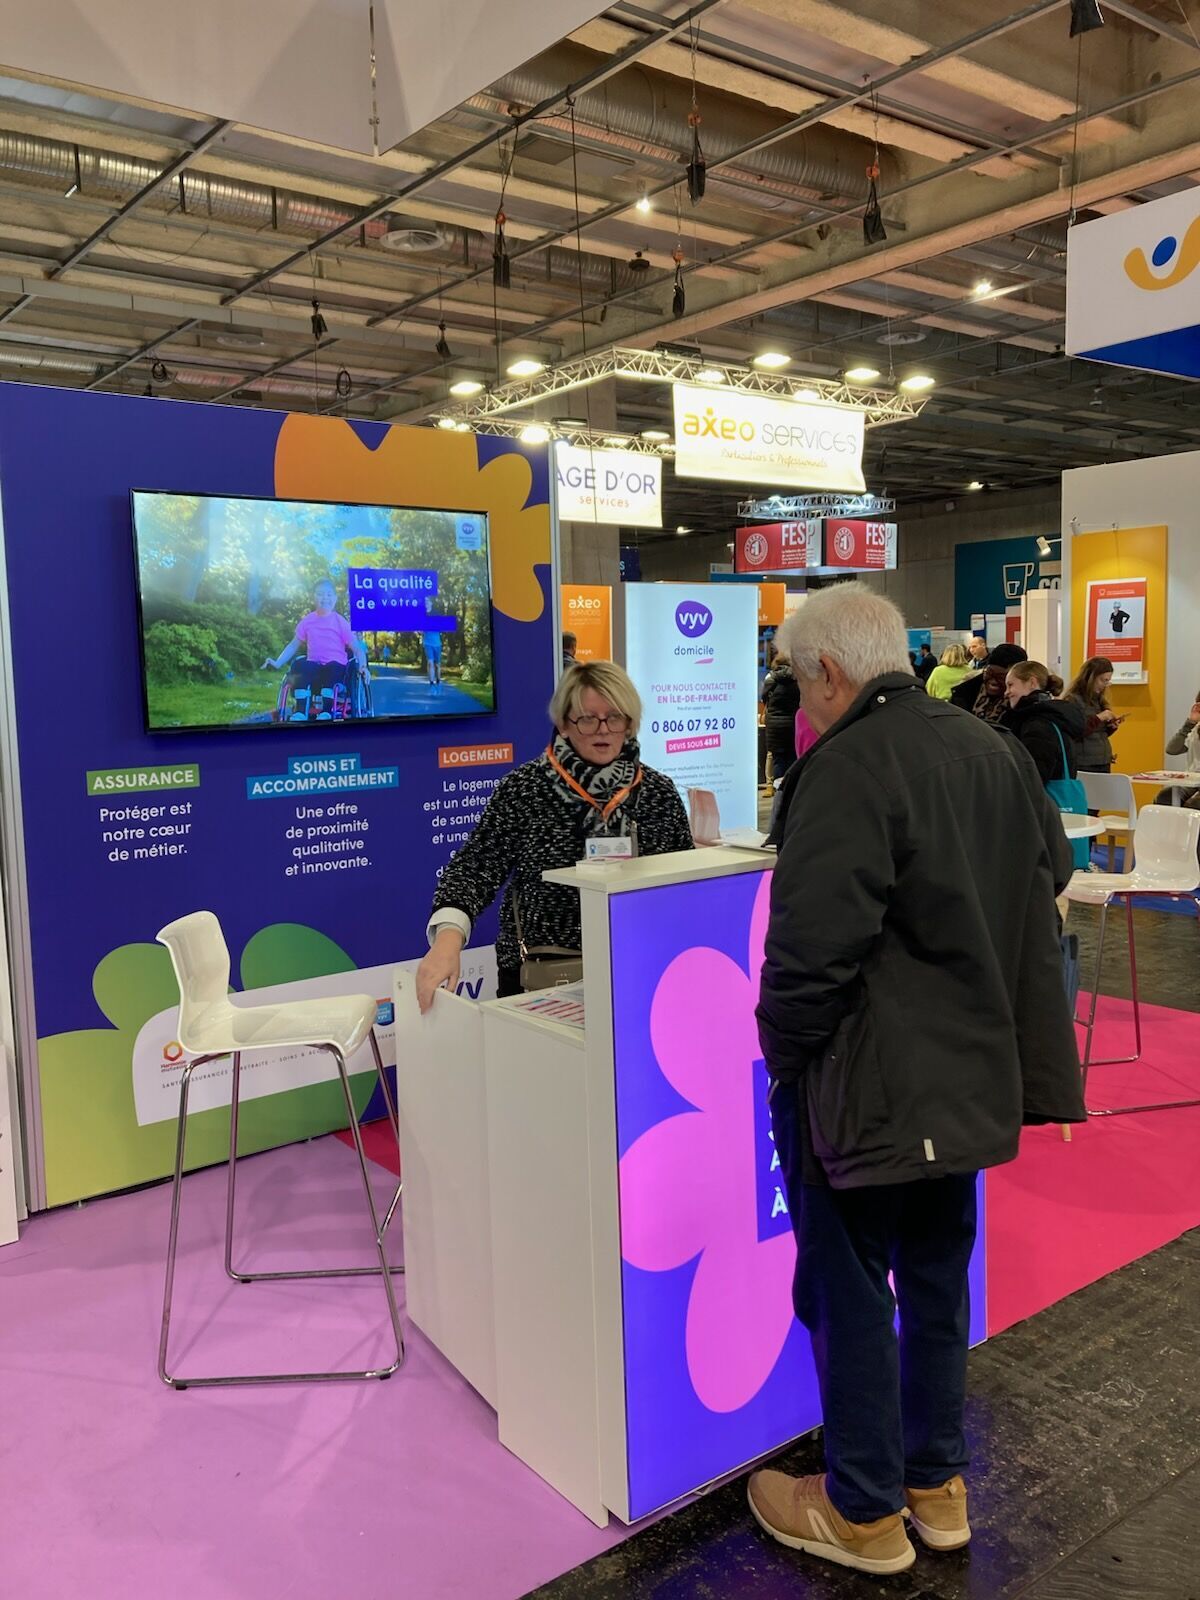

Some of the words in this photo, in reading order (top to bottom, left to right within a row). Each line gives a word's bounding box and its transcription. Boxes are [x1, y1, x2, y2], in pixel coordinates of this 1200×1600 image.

[683, 407, 755, 442] axeo
[605, 470, 656, 495] D'OR
[579, 496, 630, 508] services
[781, 522, 816, 546] FESP
[865, 522, 893, 545] FESP
[354, 574, 373, 589] La
[378, 575, 433, 591] qualité
[356, 597, 375, 609] de
[381, 598, 418, 607] votre
[568, 595, 601, 608] axeo
[679, 612, 708, 629] vyv
[674, 645, 714, 655] domicile
[651, 684, 672, 692] POUR
[673, 683, 694, 692] NOUS
[695, 682, 736, 691] CONTACTER
[657, 695, 668, 704] EN
[669, 693, 728, 703] ÎLE-DE-FRANCE
[651, 721, 659, 733] 0
[662, 720, 684, 733] 806
[687, 719, 701, 731] 07
[704, 718, 718, 730] 92
[721, 717, 736, 729] 80
[668, 741, 686, 751] DEVIS
[687, 740, 704, 749] SOUS
[443, 748, 510, 764] LOGEMENT
[293, 760, 336, 774] SOINS
[340, 758, 356, 771] ET
[93, 770, 194, 790] ASSURANCE
[252, 771, 395, 795] ACCOMPAGNEMENT
[443, 781, 456, 792] Le
[459, 778, 500, 793] logeme
[295, 806, 323, 819] Une
[327, 803, 358, 816] offre
[423, 799, 441, 811] est
[444, 799, 459, 809] un
[461, 795, 492, 808] déter
[100, 805, 166, 822] Protéger
[169, 802, 192, 815] est
[432, 815, 447, 827] de
[450, 811, 481, 825] santé
[103, 827, 145, 842] notre
[149, 823, 191, 837] cœur
[285, 827, 303, 839] de
[307, 819, 369, 840] proximité
[432, 833, 444, 844] et
[447, 831, 469, 843] une
[108, 848, 129, 862] de
[134, 843, 188, 859] métier.
[292, 839, 364, 859] qualitative
[285, 865, 299, 876] et
[302, 856, 372, 874] innovante.
[191, 1069, 228, 1082] SSURANCES
